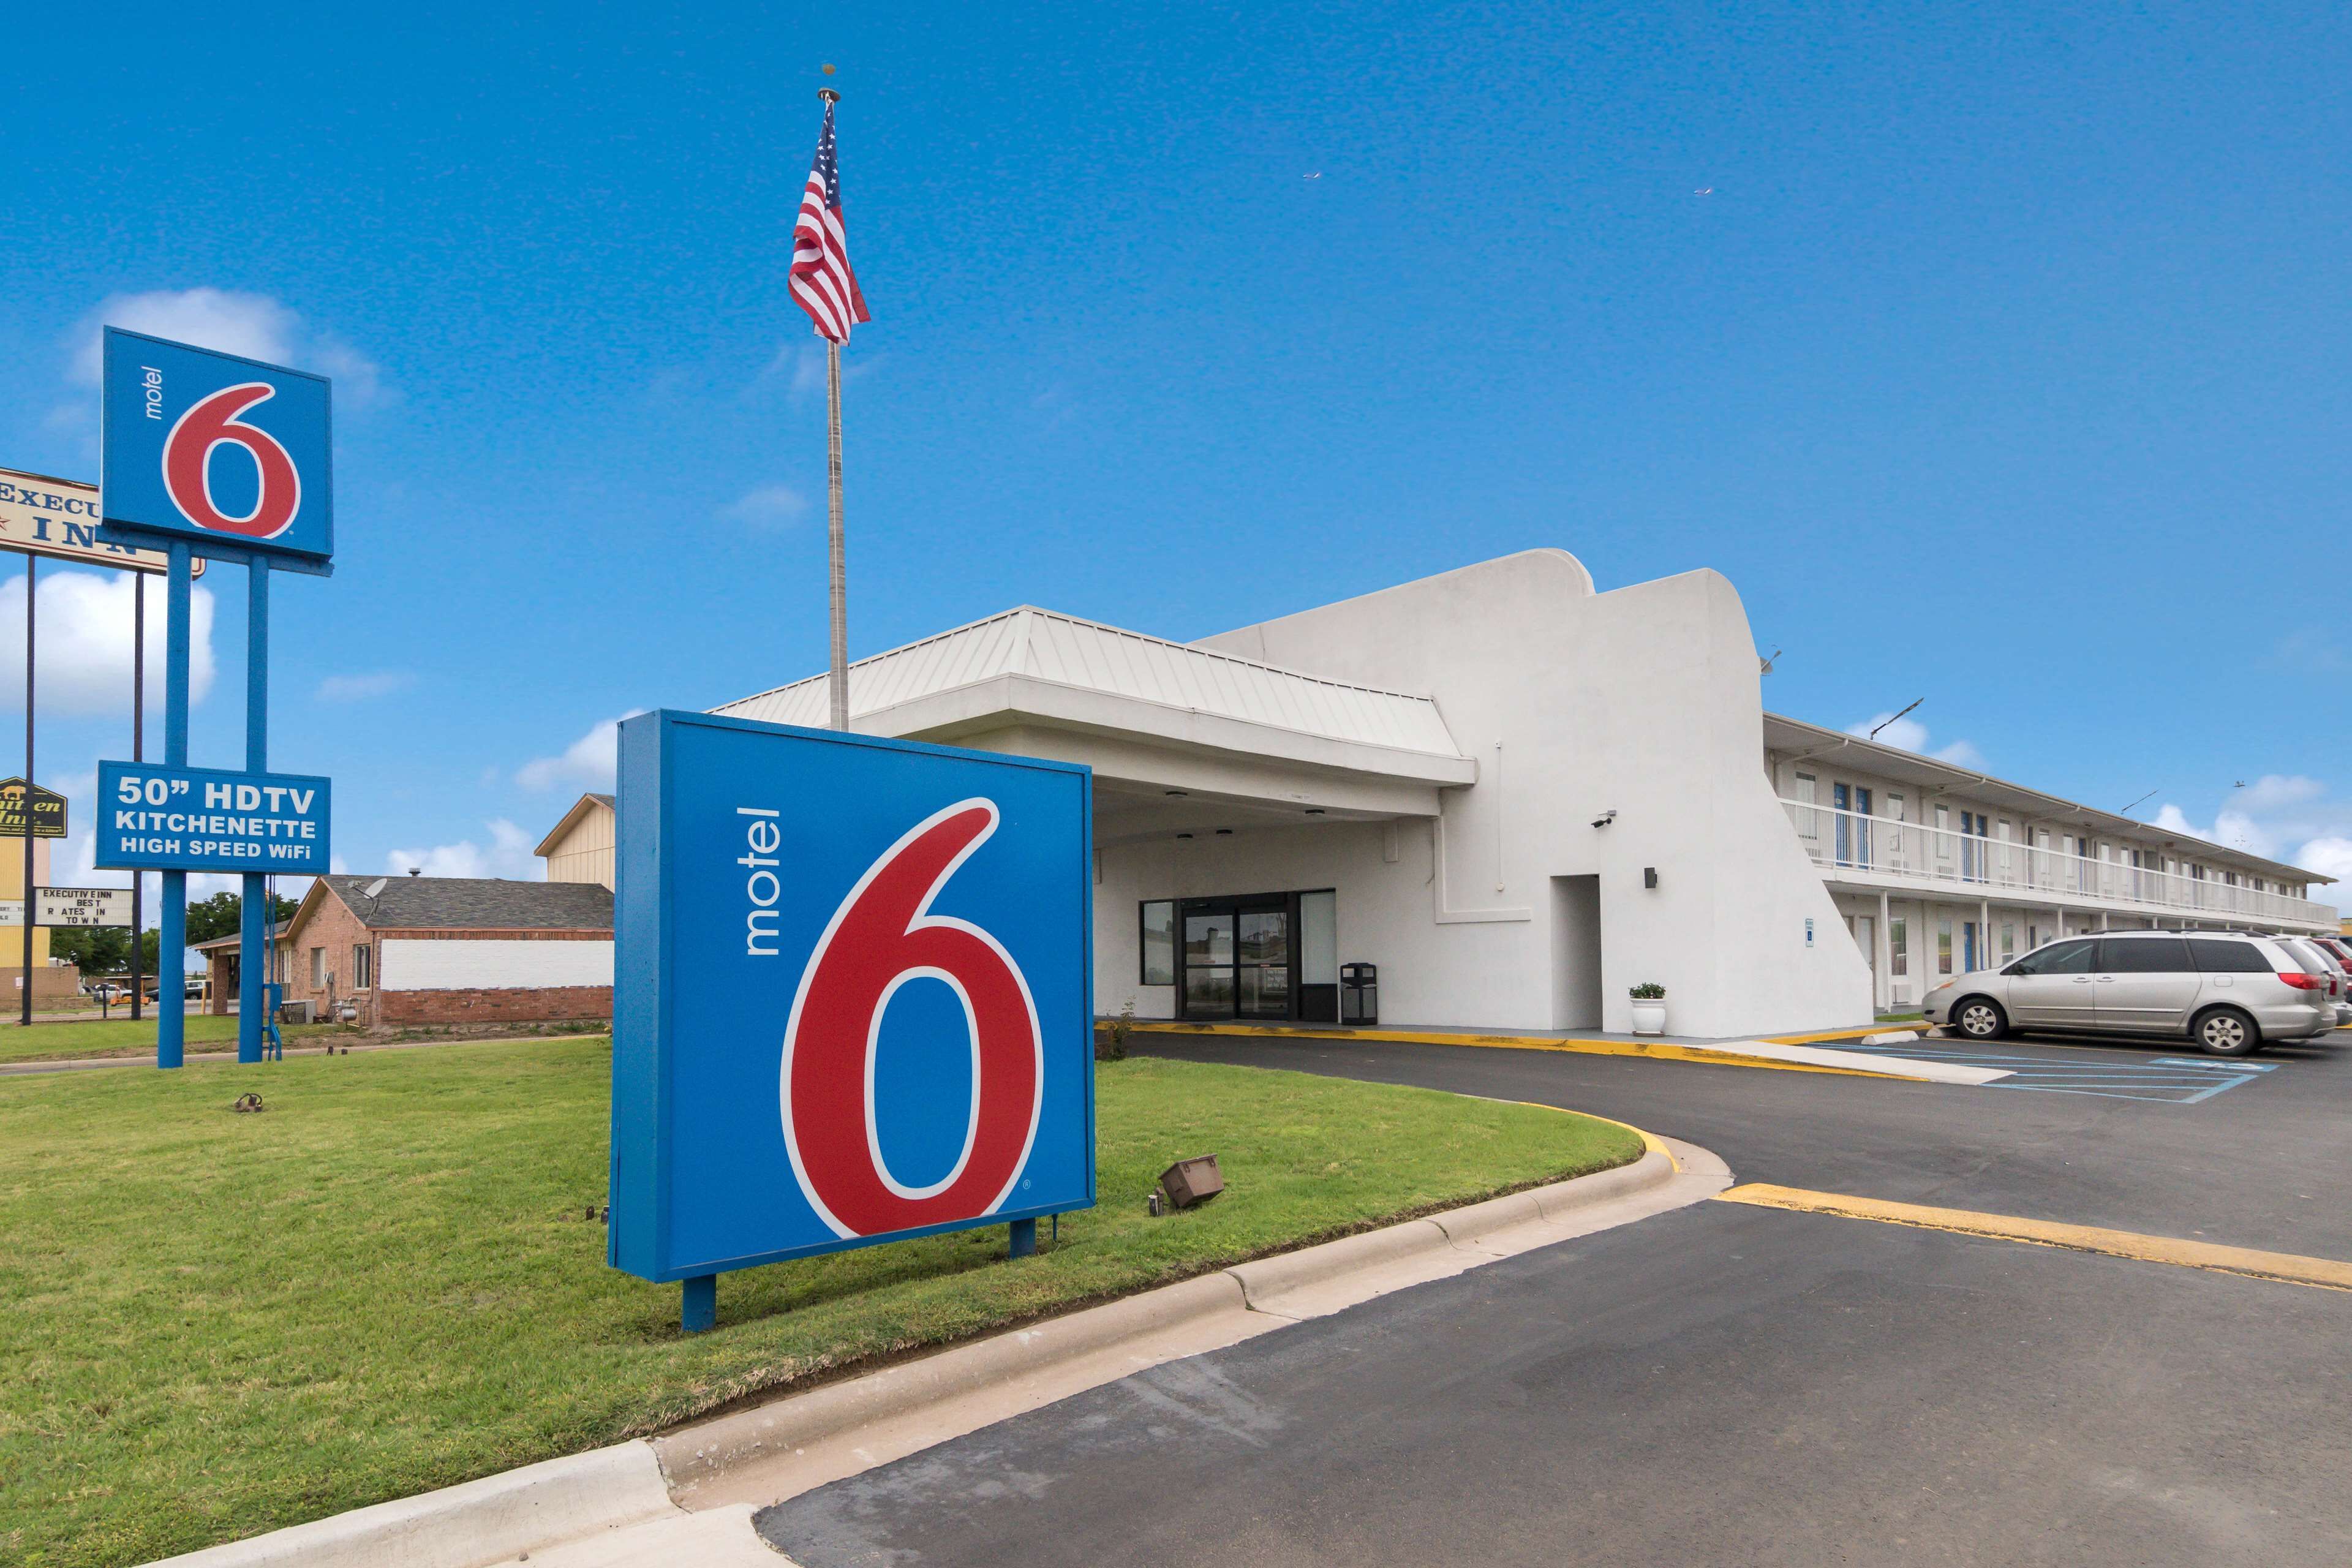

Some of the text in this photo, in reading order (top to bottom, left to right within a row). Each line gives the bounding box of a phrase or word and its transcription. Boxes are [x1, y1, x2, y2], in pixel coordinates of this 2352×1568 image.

[141, 366, 301, 540] motel 6
[205, 782, 315, 815] HDTV
[116, 810, 315, 839] KITCHENETTE
[121, 837, 311, 859] HIGH SPEED WiFi
[43, 889, 96, 898] EXECUTIVE
[736, 797, 1044, 1238] motel 6
